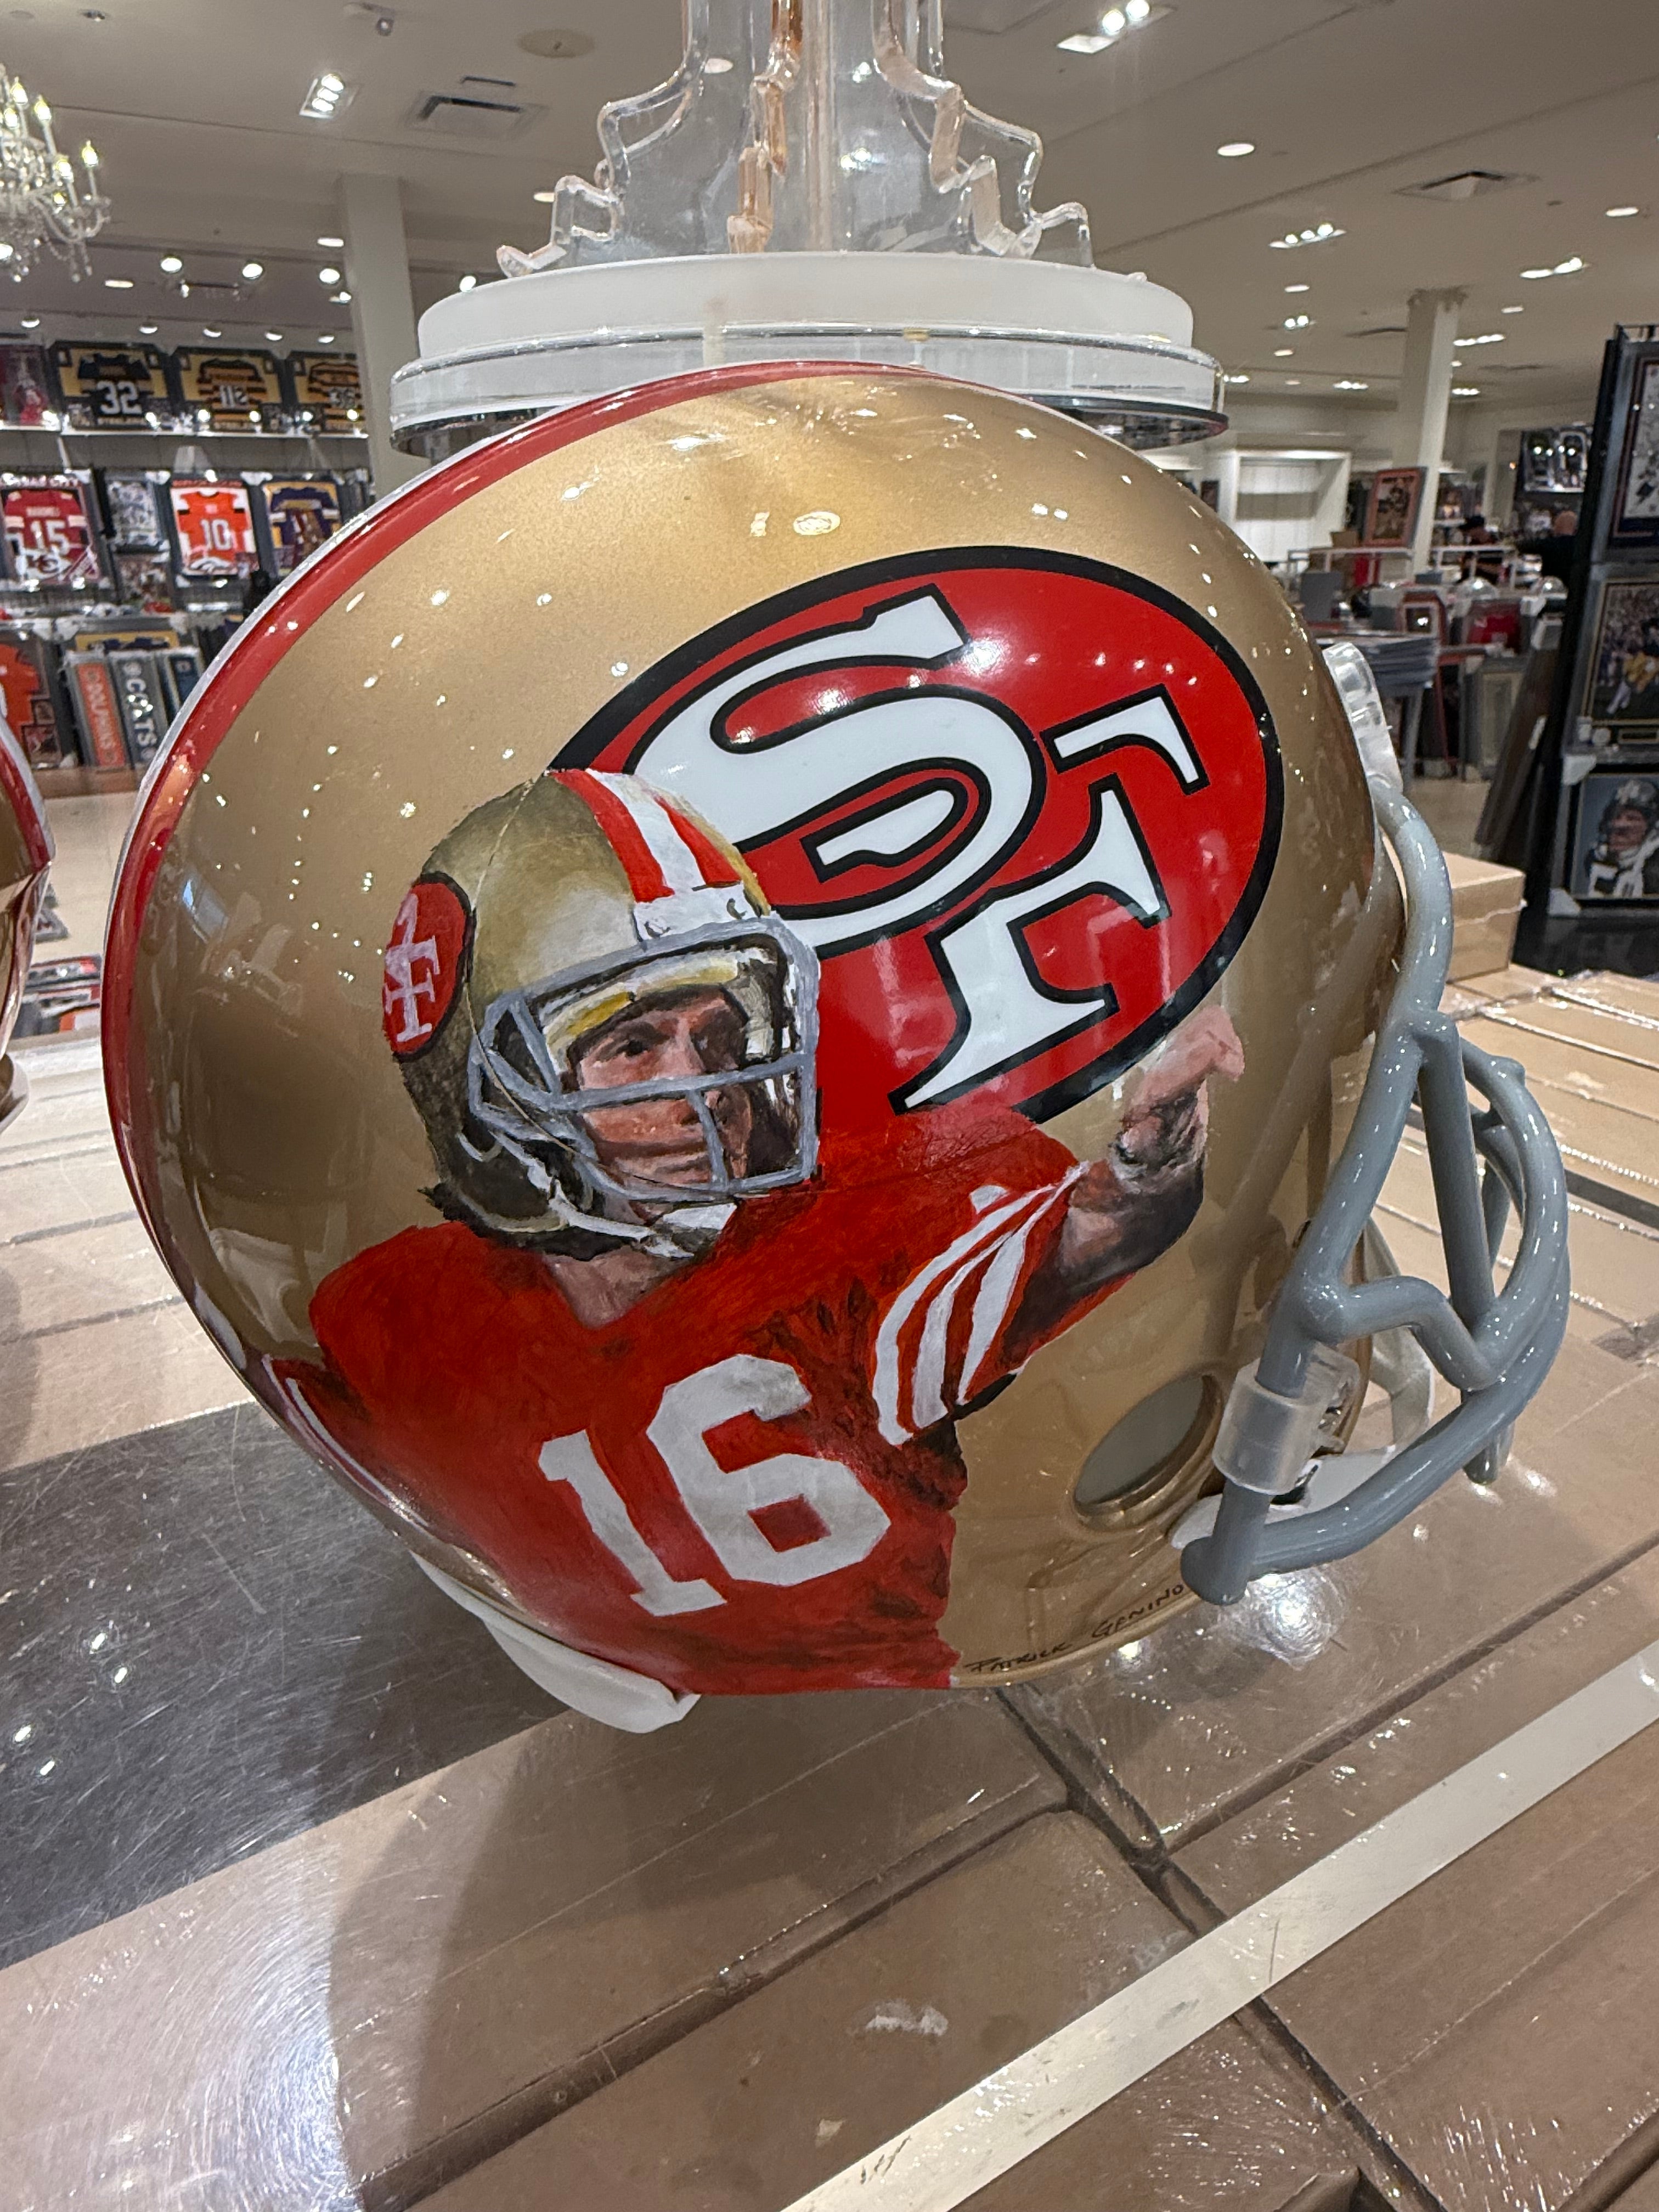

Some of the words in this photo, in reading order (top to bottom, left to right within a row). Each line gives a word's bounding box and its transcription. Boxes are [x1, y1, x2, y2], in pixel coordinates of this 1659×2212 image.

[97, 380, 142, 415] 32
[30, 520, 70, 555] 15
[200, 518, 232, 550] 10
[538, 1353, 892, 1617] 16
